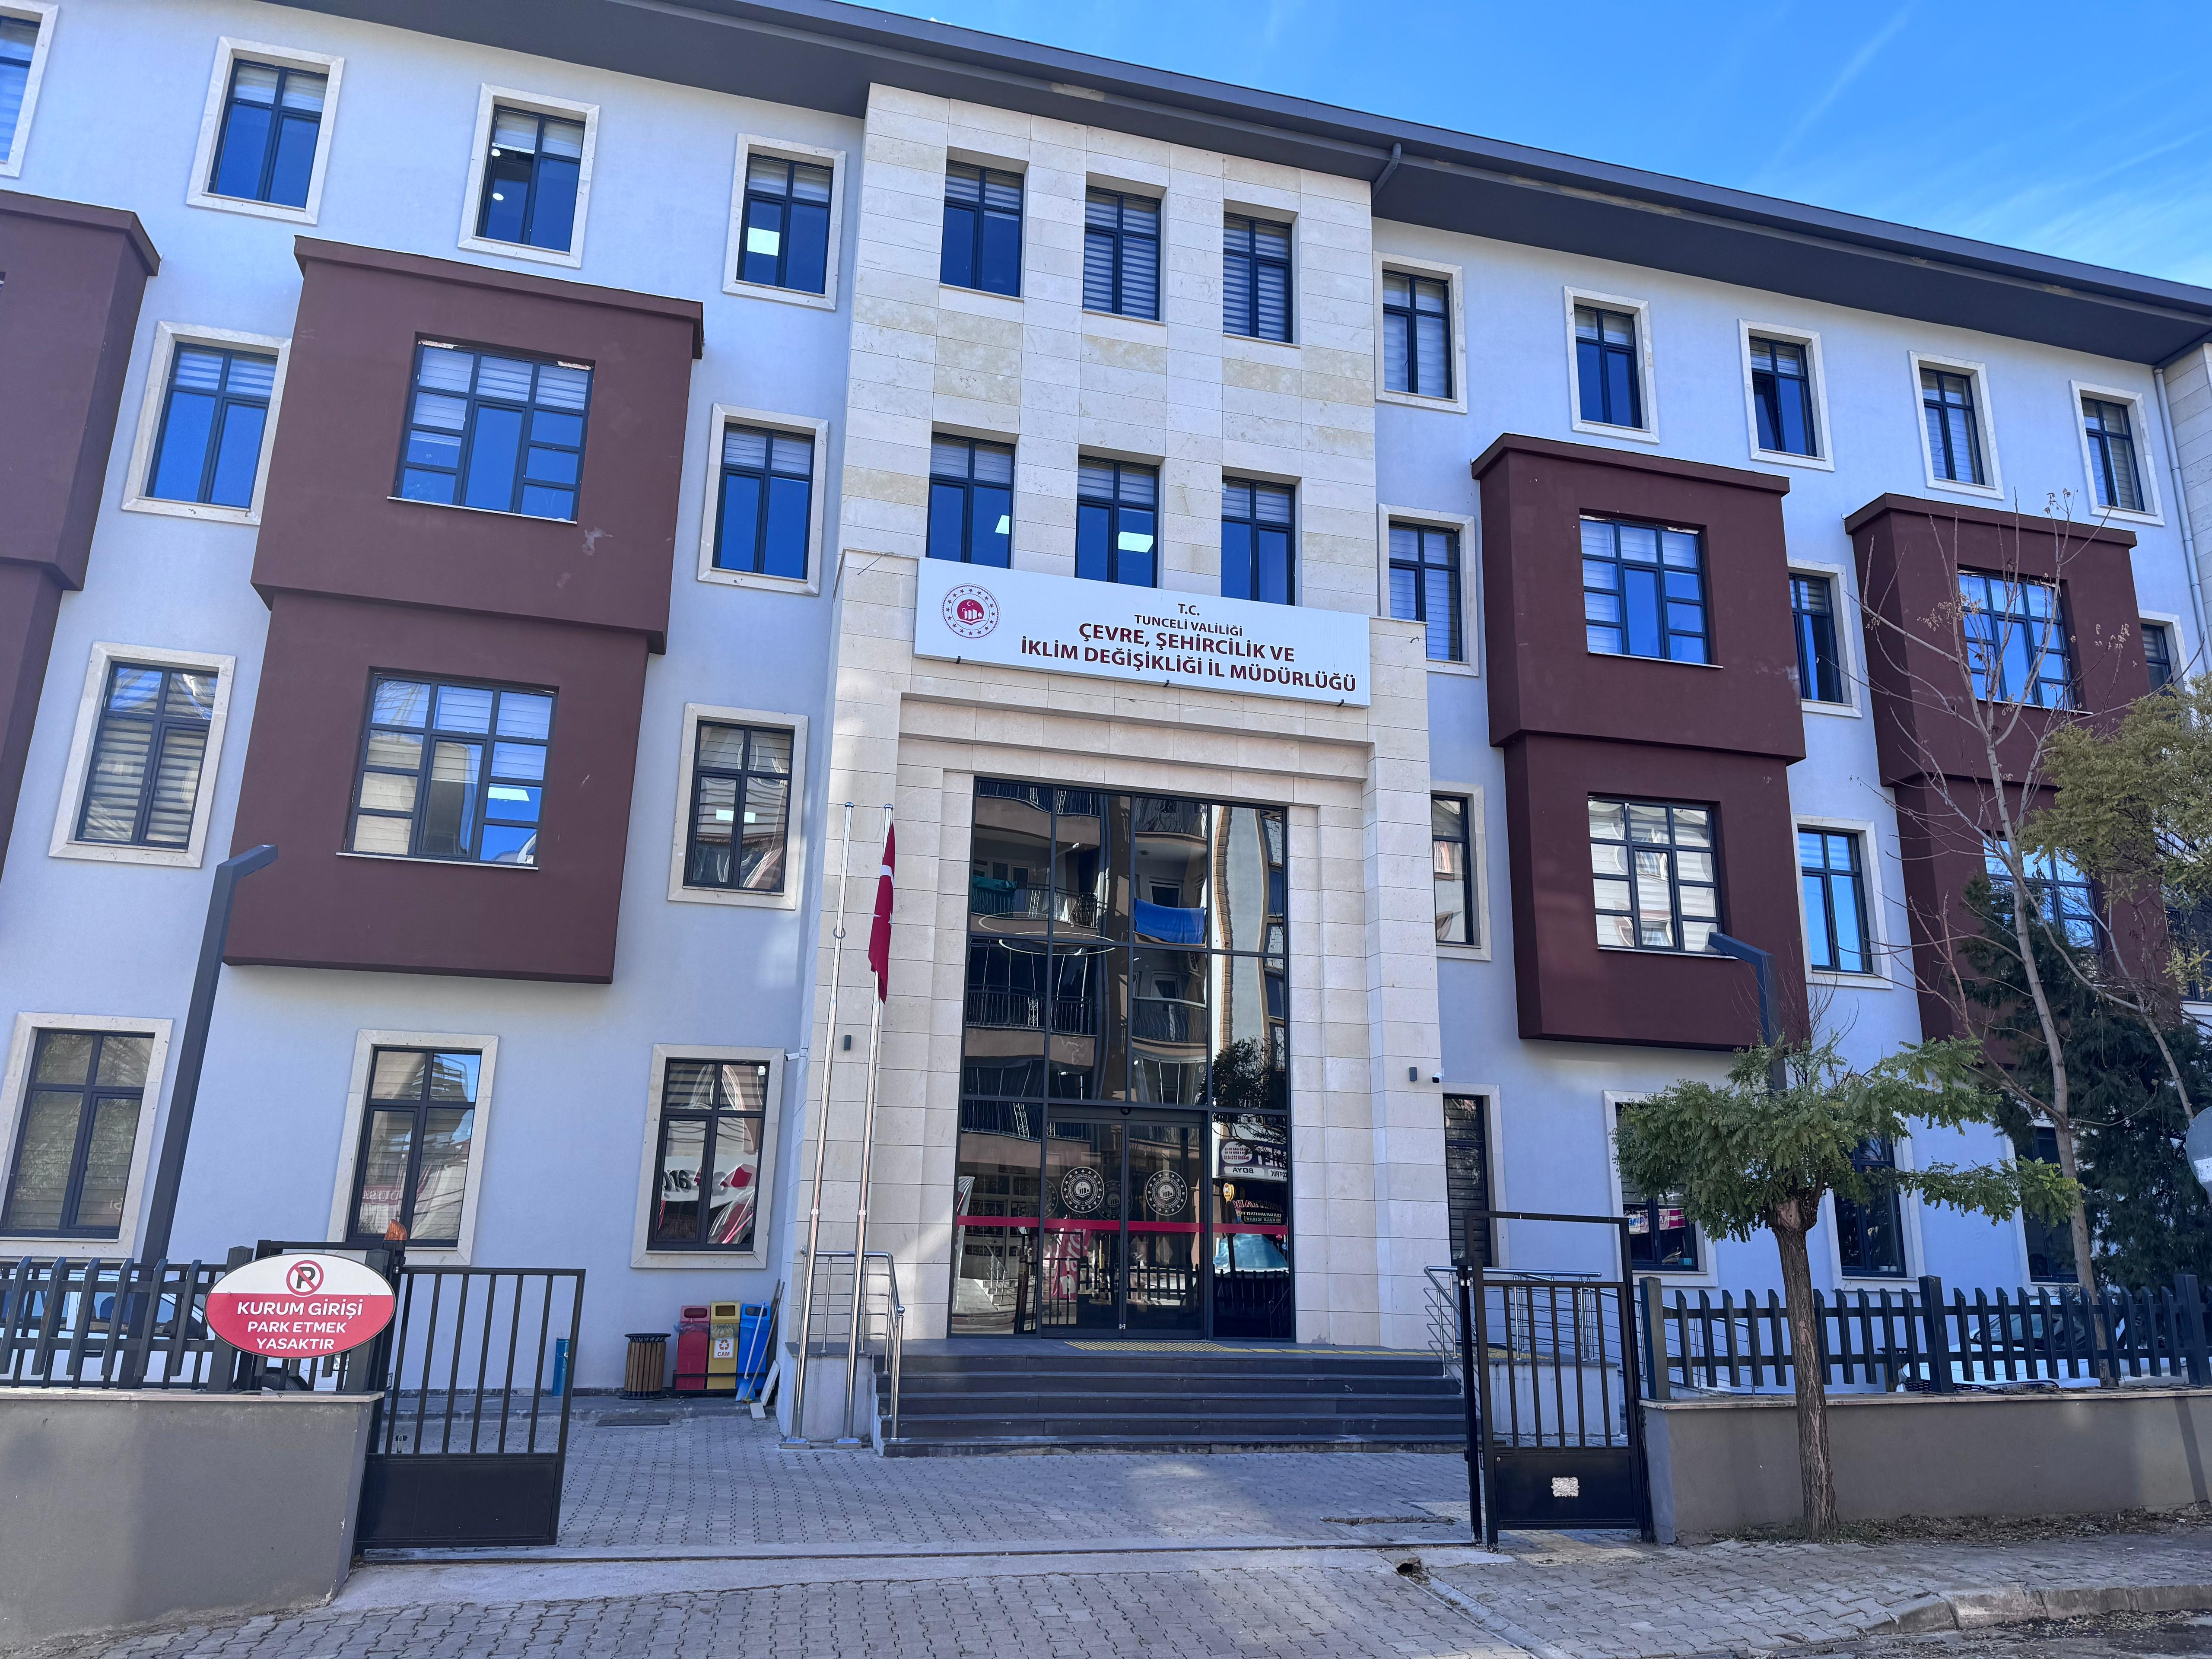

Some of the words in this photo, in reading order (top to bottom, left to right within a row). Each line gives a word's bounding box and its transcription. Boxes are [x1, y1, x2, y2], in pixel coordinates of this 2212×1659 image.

[1178, 603, 1200, 616] T.C.
[1134, 614, 1187, 629] TUNCELİ
[1191, 622, 1242, 636] VALİLİĞİ
[1079, 623, 1150, 647] ÇEVRE,
[1156, 632, 1265, 659] ŞEHİRCİLİK
[1270, 645, 1294, 662] VE
[1022, 636, 1078, 660] İKLİM
[1085, 647, 1202, 674] DEĞİŞİKLİĞİ
[1209, 658, 1225, 677] İL
[1230, 663, 1356, 691] MÜDÜRLÜĞÜ
[237, 1301, 304, 1316] KURUM
[308, 1298, 363, 1320] GİRİŞİ
[247, 1321, 290, 1333] PARK
[293, 1321, 347, 1333] ETMEK
[256, 1338, 334, 1350] YASAKTIR
